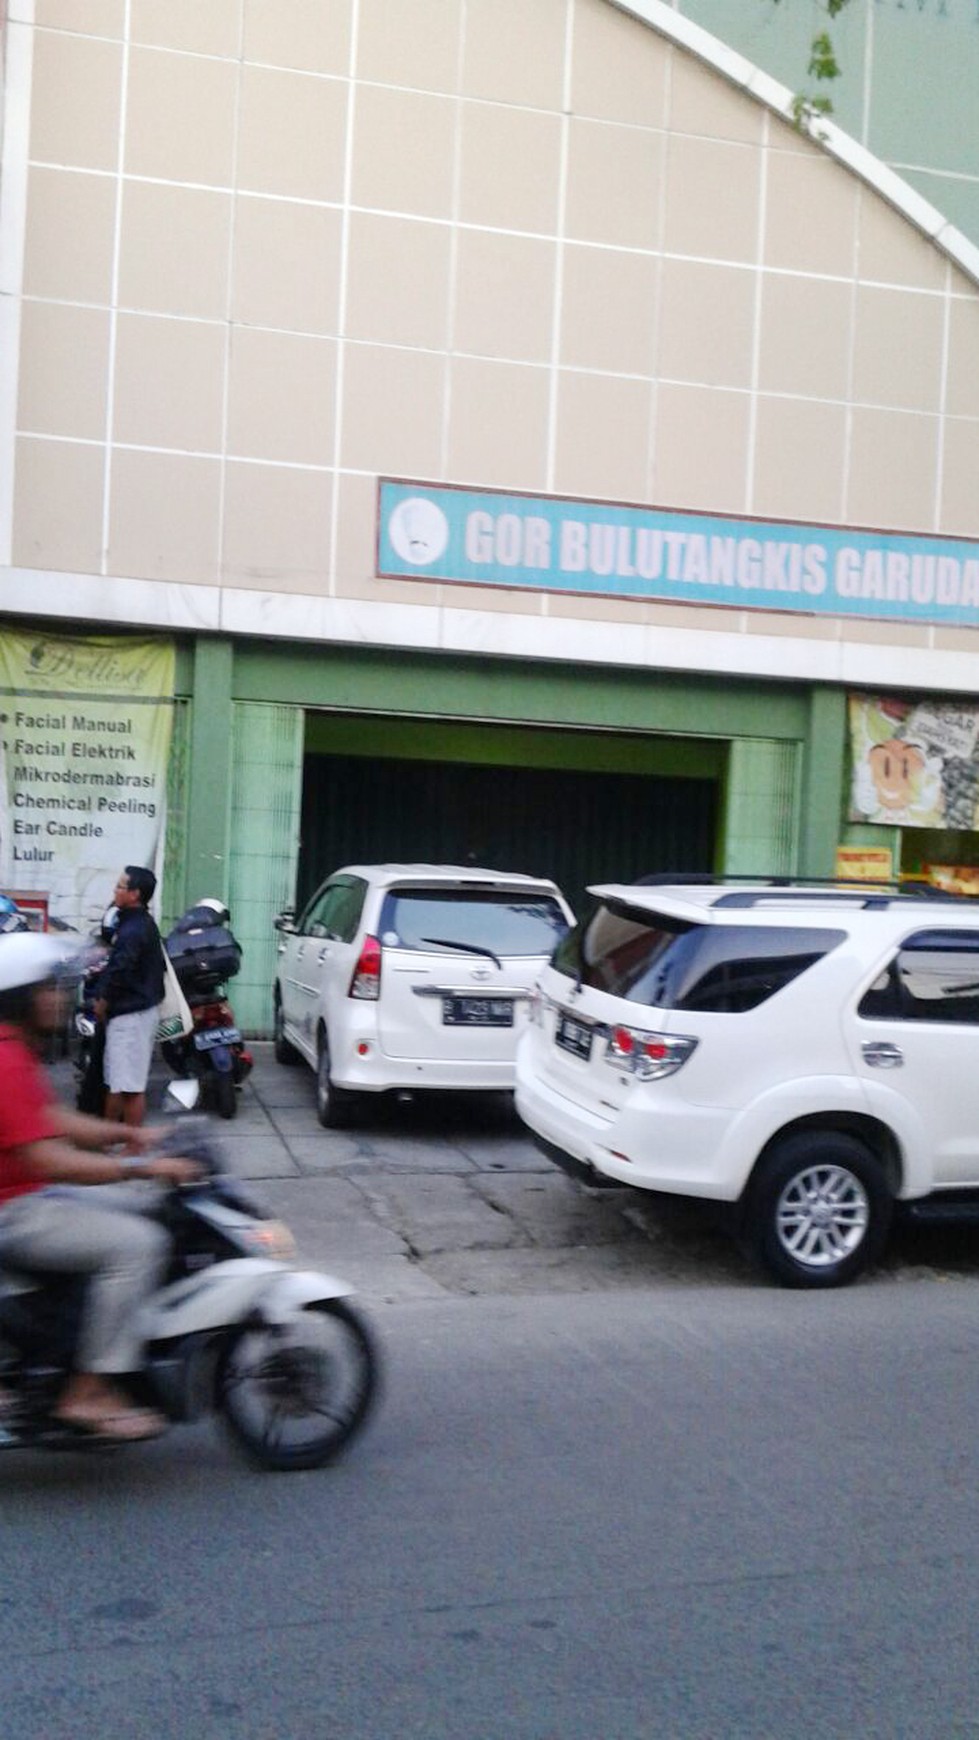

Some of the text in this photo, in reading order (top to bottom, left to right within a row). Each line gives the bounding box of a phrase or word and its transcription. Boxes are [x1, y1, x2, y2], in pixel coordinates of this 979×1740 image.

[465, 509, 979, 607] GOR BULUTANGKIS GARUDA
[14, 712, 132, 734] Facial Manual
[14, 739, 136, 761] Facial Elektrik
[13, 766, 156, 788] Mikrodermabrasi
[13, 792, 156, 818] Chemical Peeling
[13, 820, 103, 838] Ear Candle
[12, 846, 55, 862] Lulur
